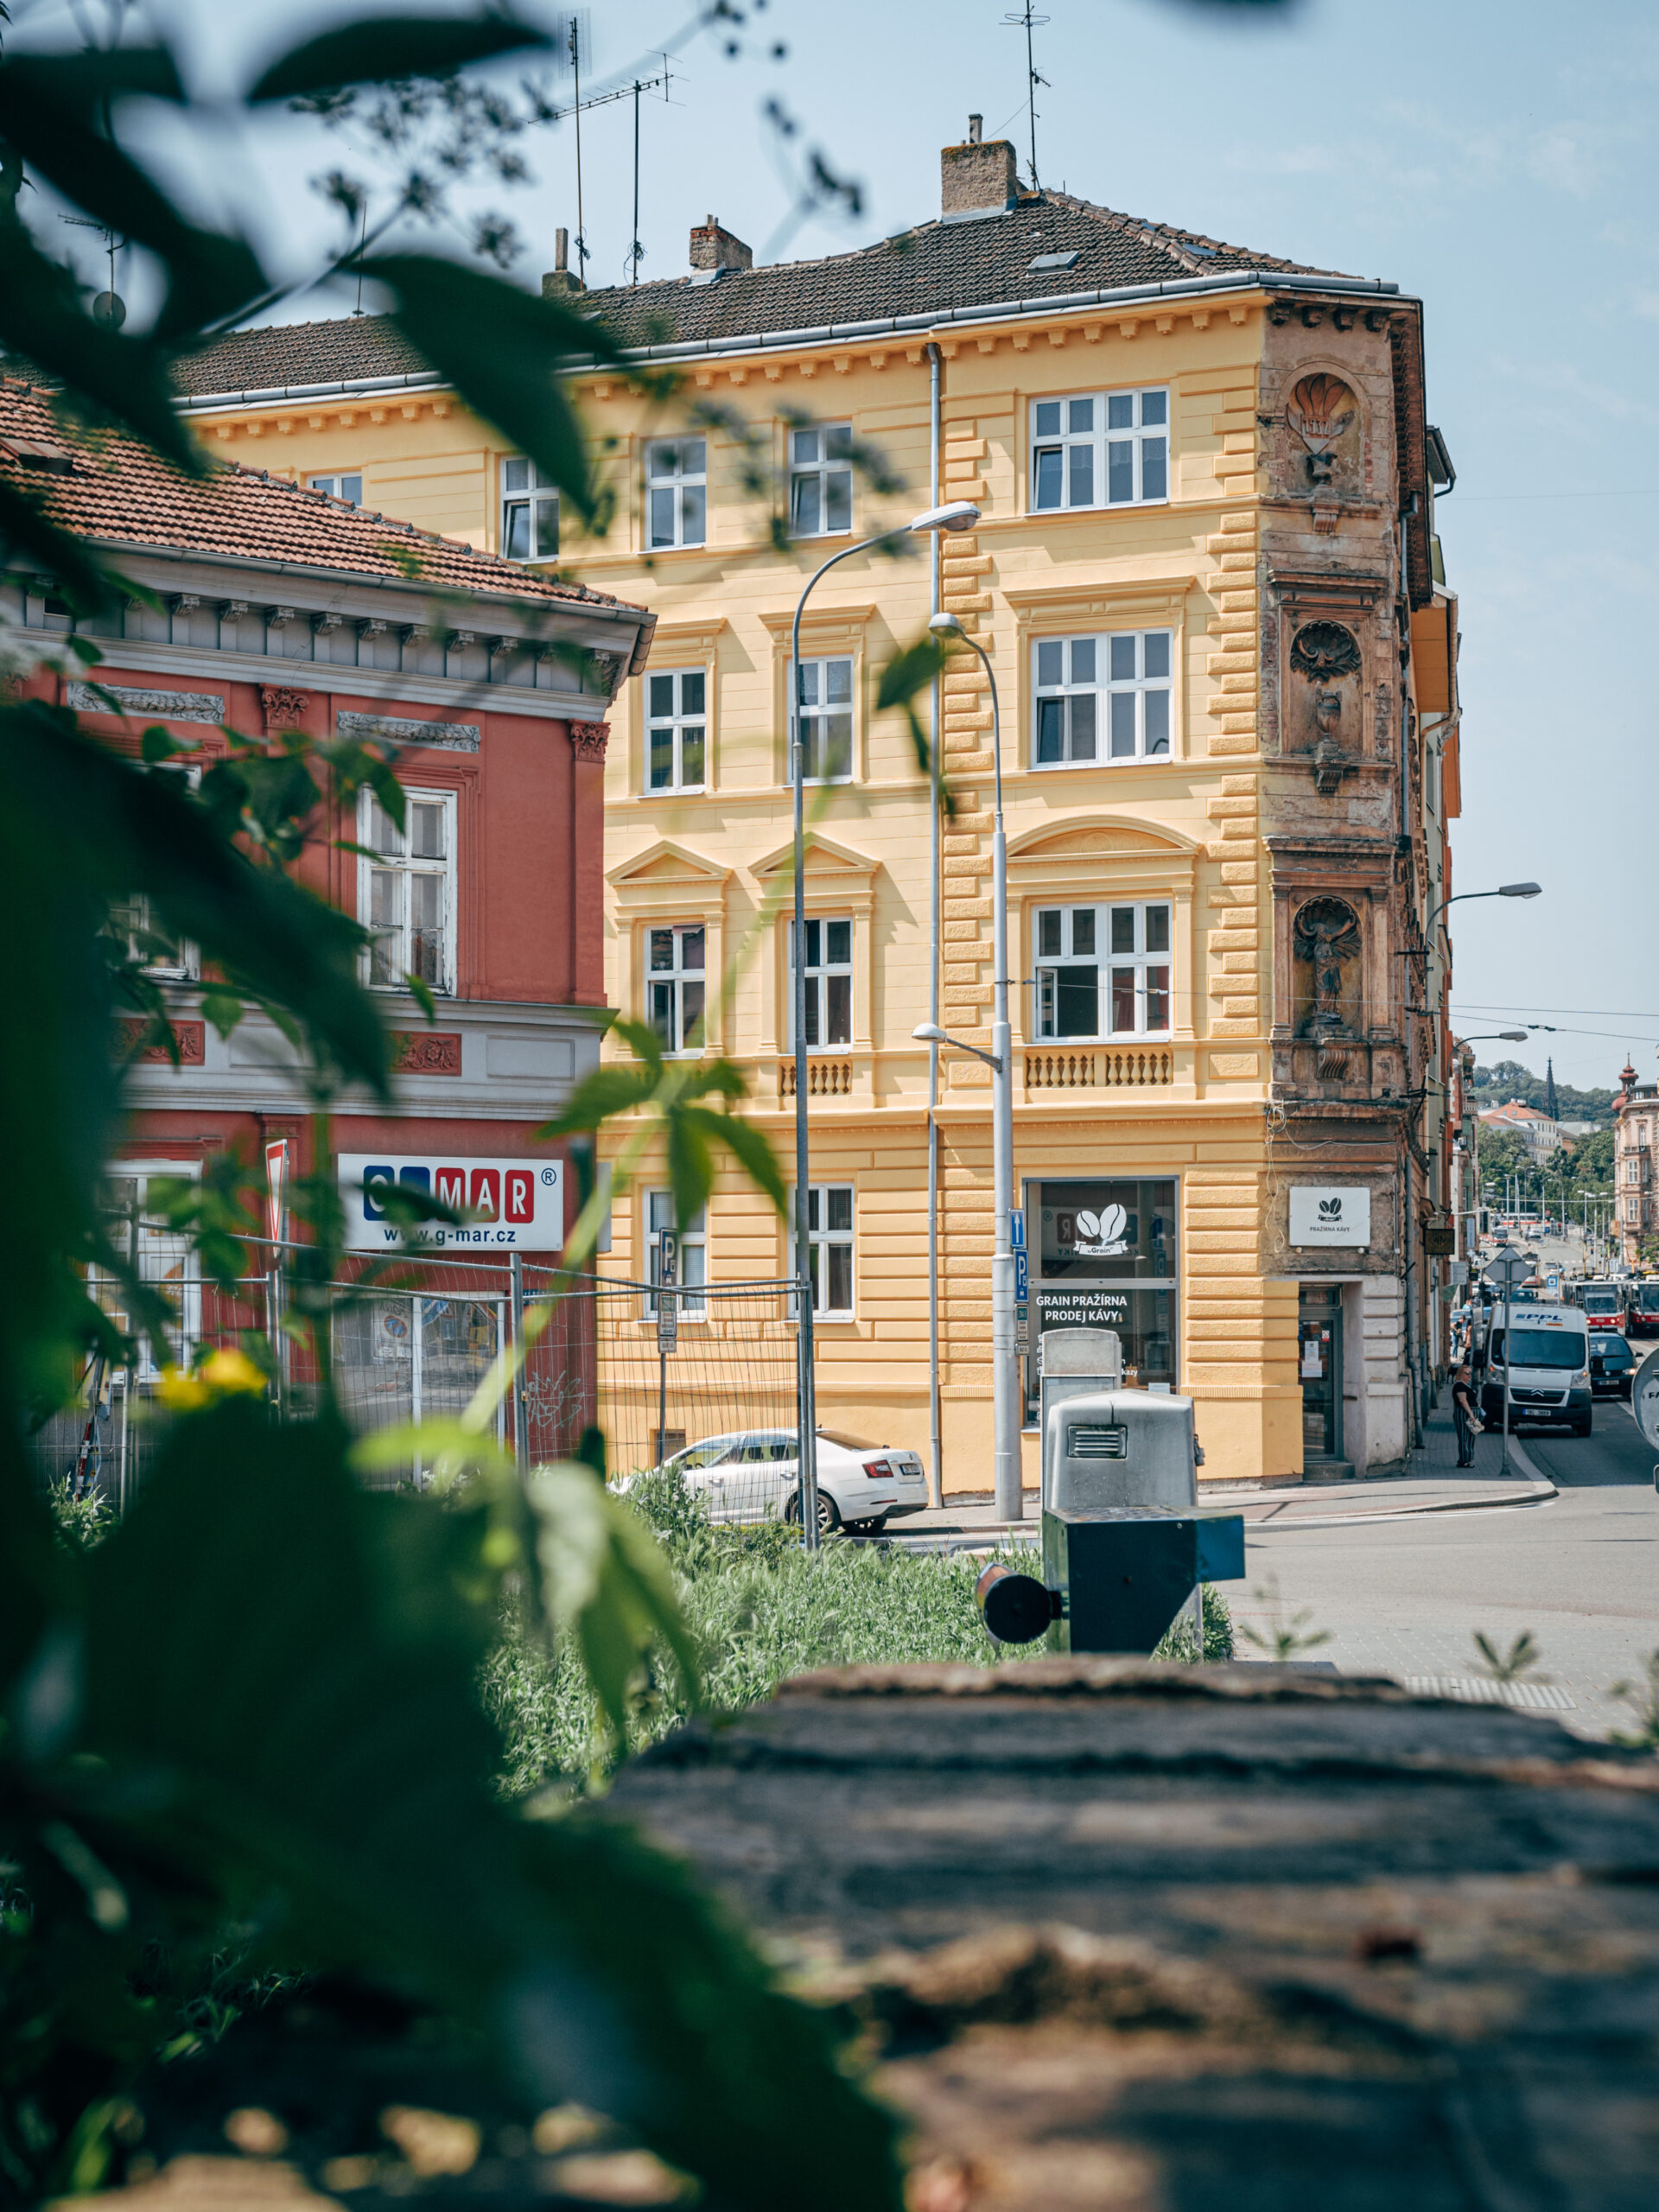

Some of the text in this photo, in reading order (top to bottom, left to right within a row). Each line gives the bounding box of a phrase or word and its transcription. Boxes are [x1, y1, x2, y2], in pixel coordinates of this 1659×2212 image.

[369, 1173, 526, 1216] MAR
[1036, 1294, 1127, 1306] GRAIN PRAŽÍRNA
[1045, 1309, 1118, 1323] PRODEJ KÁVY
